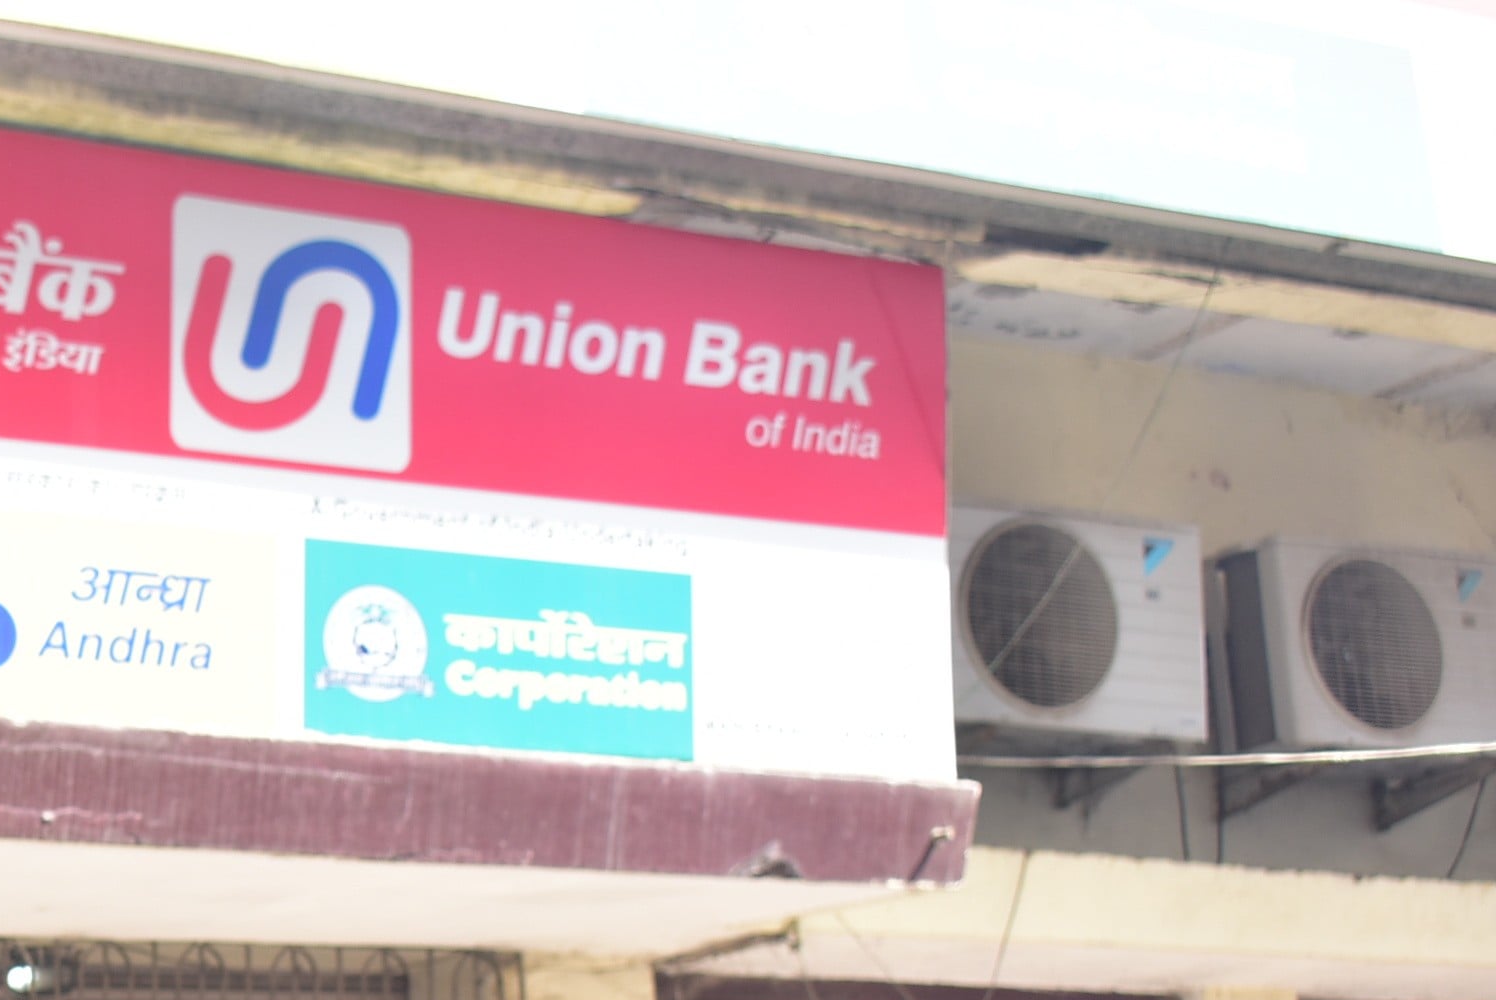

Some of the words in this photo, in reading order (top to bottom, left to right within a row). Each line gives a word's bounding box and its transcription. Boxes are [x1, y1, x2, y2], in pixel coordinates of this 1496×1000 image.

[2, 328, 105, 375] इंडिया
[437, 286, 666, 380] Union
[685, 320, 875, 406] Bank
[745, 412, 786, 448] of
[793, 415, 881, 460] India
[39, 620, 214, 670] Andhra
[444, 658, 688, 713] Corporation
